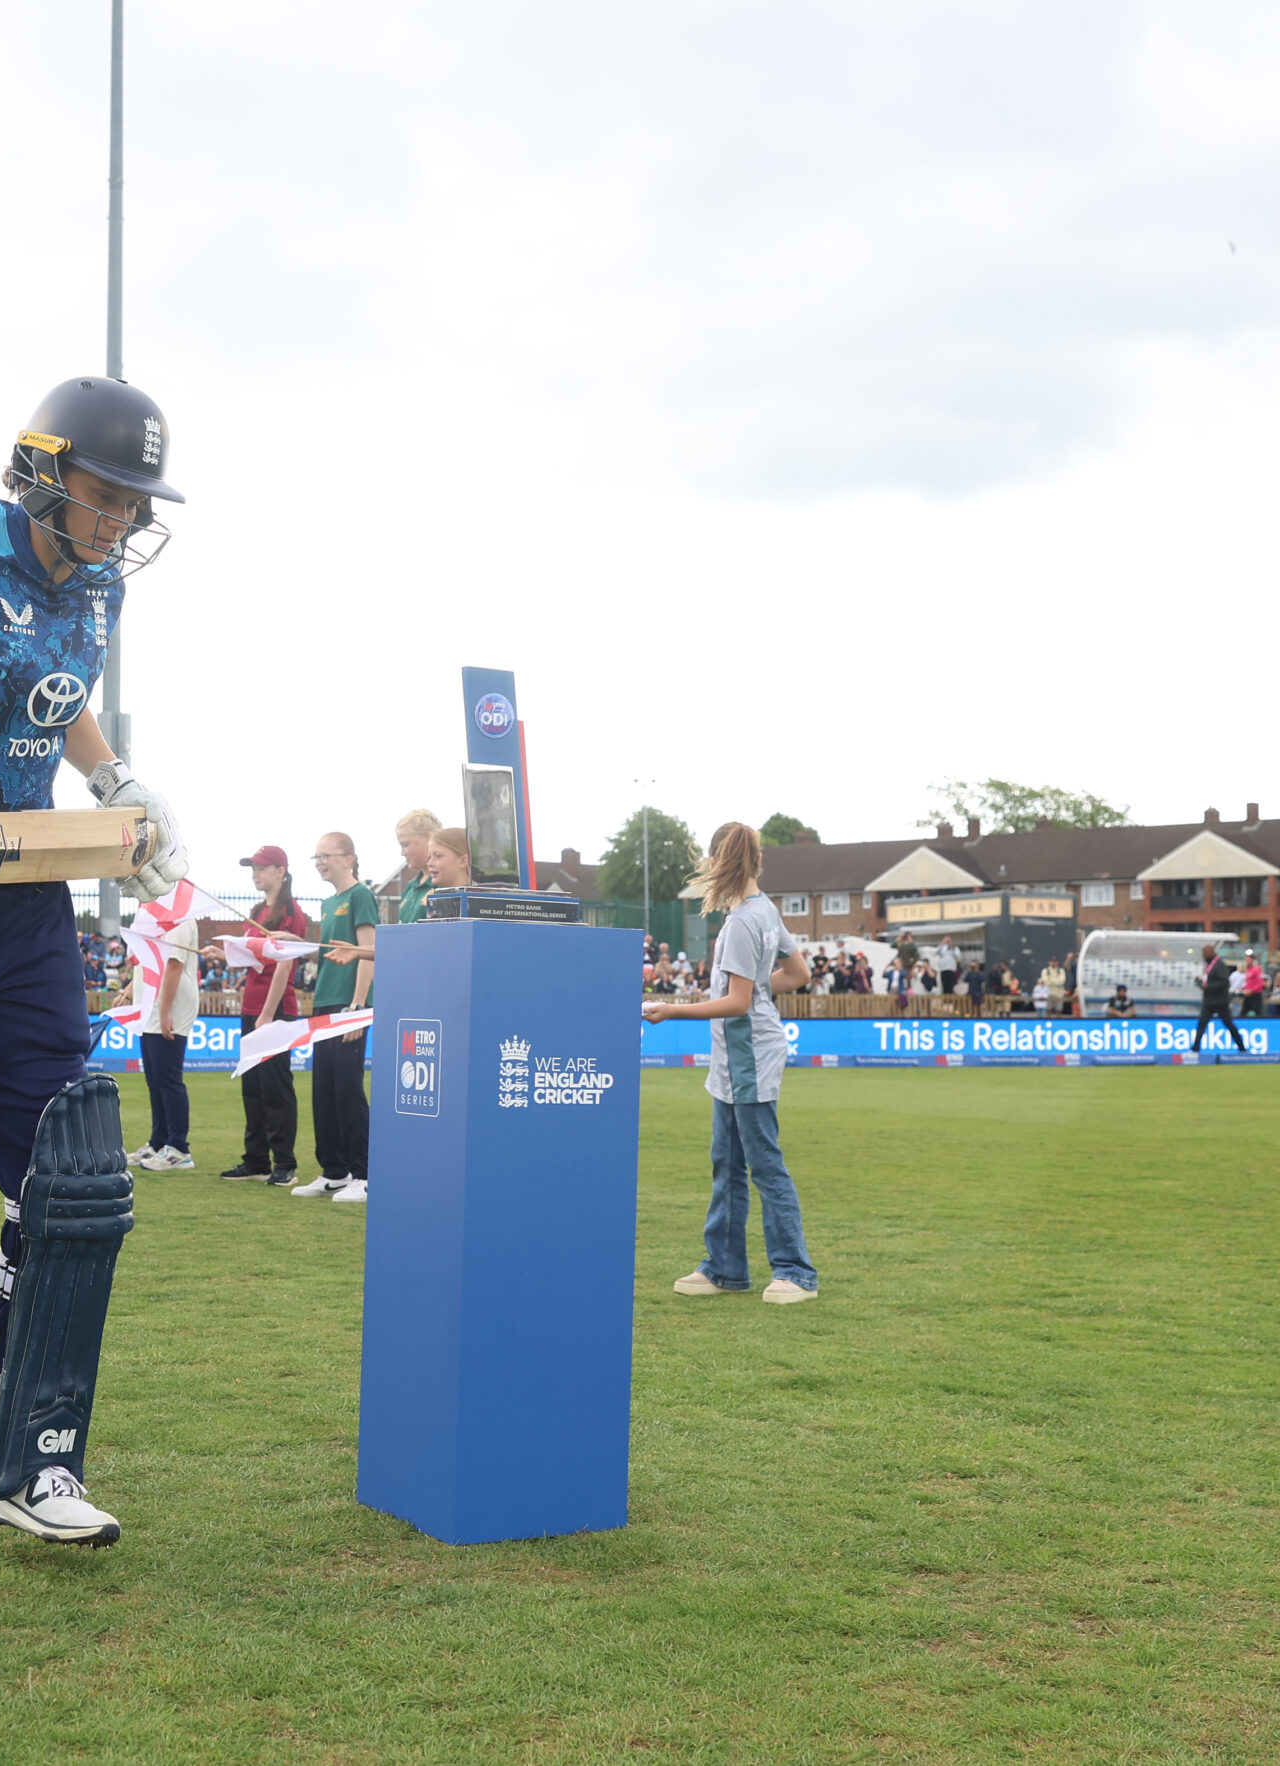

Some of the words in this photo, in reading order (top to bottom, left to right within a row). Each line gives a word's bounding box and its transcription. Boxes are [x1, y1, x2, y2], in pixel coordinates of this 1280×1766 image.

[3, 624, 37, 637] CASTORE
[481, 711, 509, 727] ODI
[8, 735, 60, 758] TOYOA
[1026, 902, 1058, 914] BAR
[401, 1029, 436, 1056] METRO
[873, 1020, 935, 1051] This
[941, 1020, 966, 1051] is
[973, 1020, 1149, 1054] Relationship
[415, 1045, 436, 1057] BANK
[534, 1056, 562, 1072] WE
[565, 1057, 597, 1073] ARE
[400, 1060, 436, 1092] ODI
[534, 1072, 614, 1088] ENGLAND
[400, 1094, 434, 1107] SERIES
[533, 1088, 604, 1105] CRICKET
[36, 1428, 78, 1454] GM
